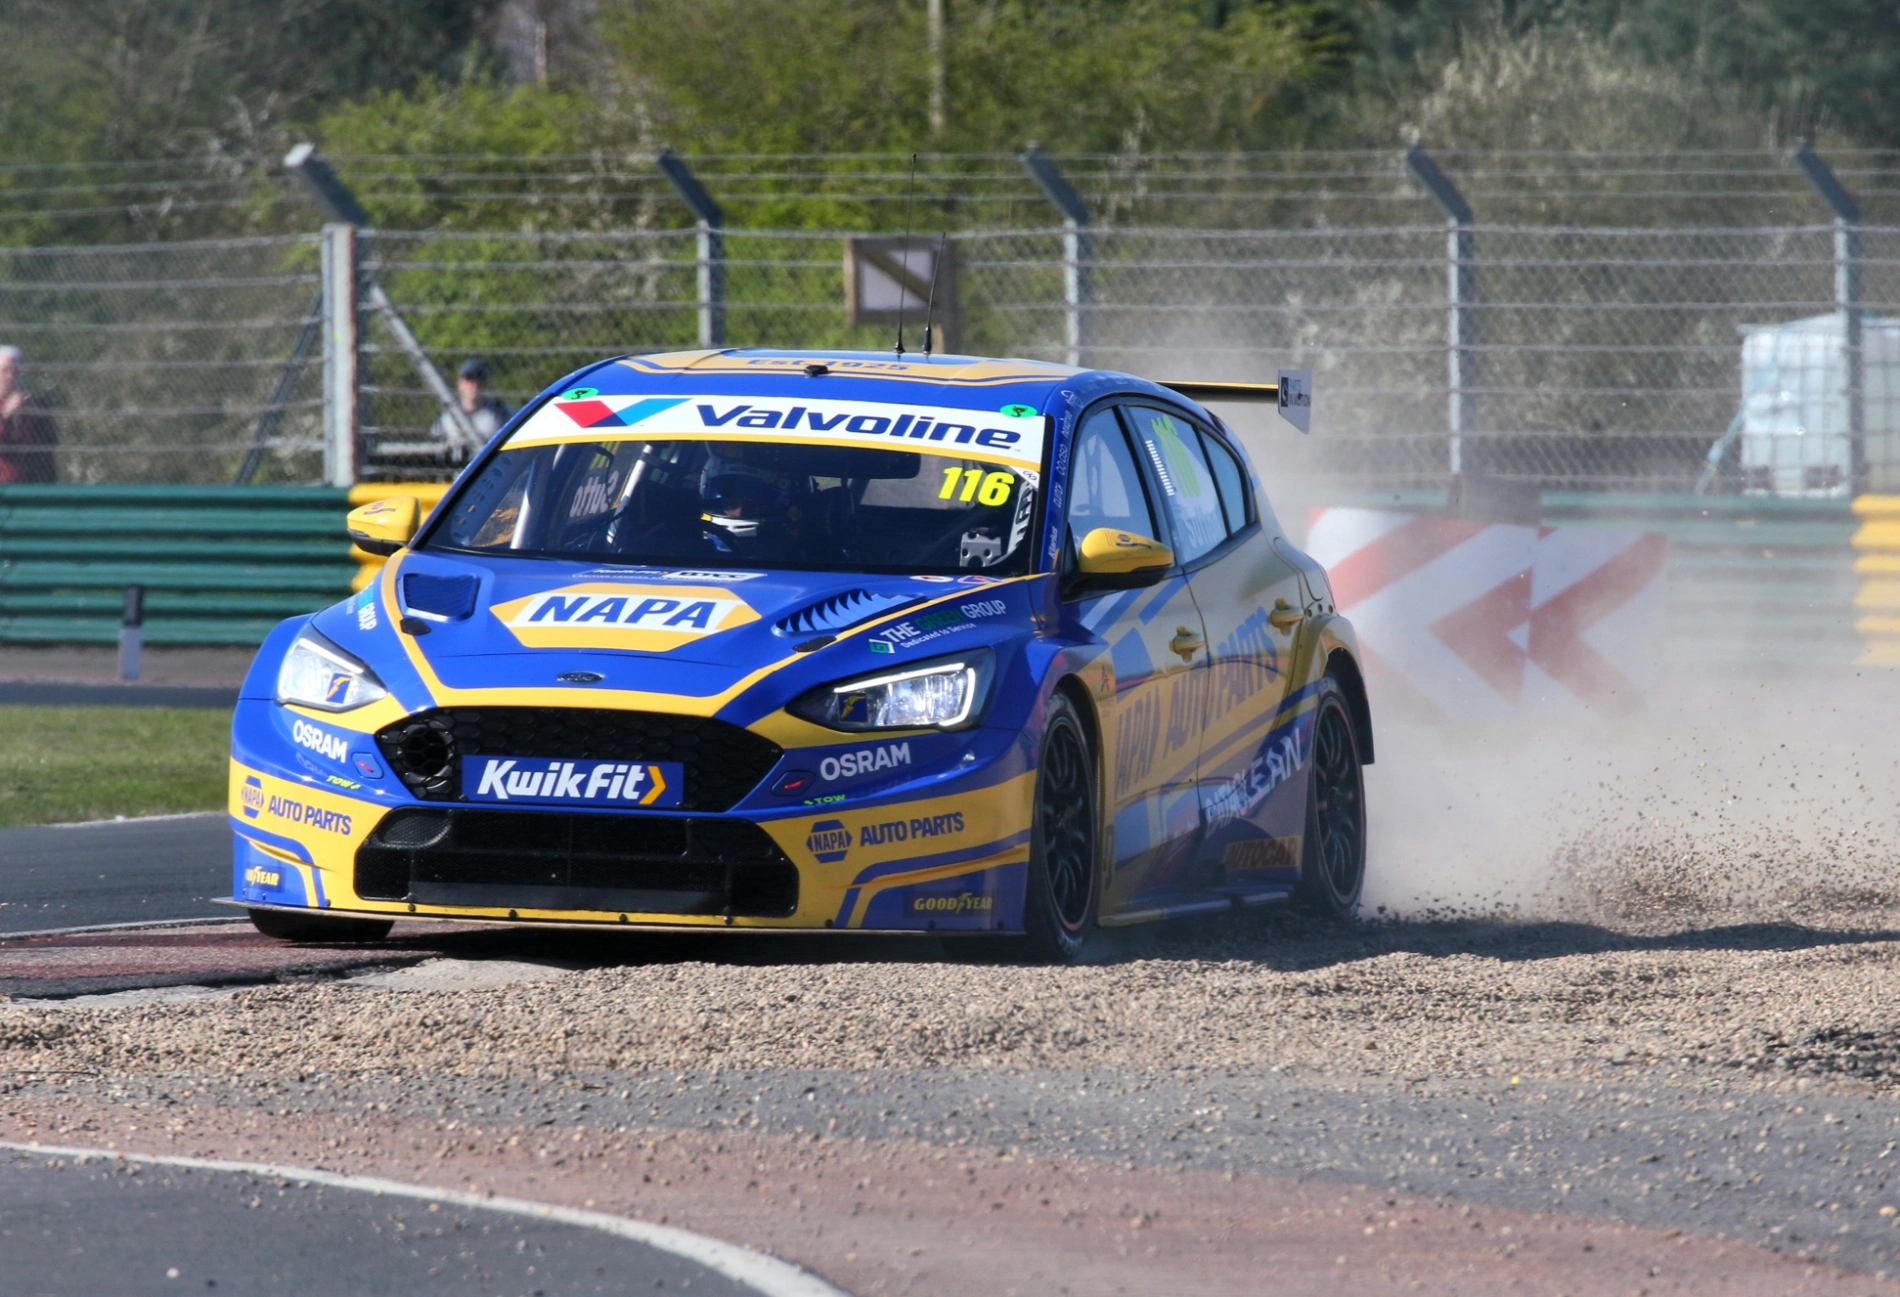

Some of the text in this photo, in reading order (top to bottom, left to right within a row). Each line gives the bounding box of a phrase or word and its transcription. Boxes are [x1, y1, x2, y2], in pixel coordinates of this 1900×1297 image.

[696, 403, 1021, 450] Valvoline
[938, 466, 1015, 507] 116
[529, 595, 716, 629] NAPA
[880, 621, 921, 643] THE
[960, 599, 1007, 619] GROUP
[1163, 658, 1216, 759] AUTO
[1214, 606, 1278, 719] PARTS
[293, 719, 348, 764] OSRAM
[819, 742, 911, 781] OSRAM
[325, 775, 354, 788] TOW
[814, 794, 846, 804] TOW
[268, 795, 303, 822] AUTO
[304, 805, 352, 835] PARTS
[812, 811, 965, 852] NAPA AUTO PARTS
